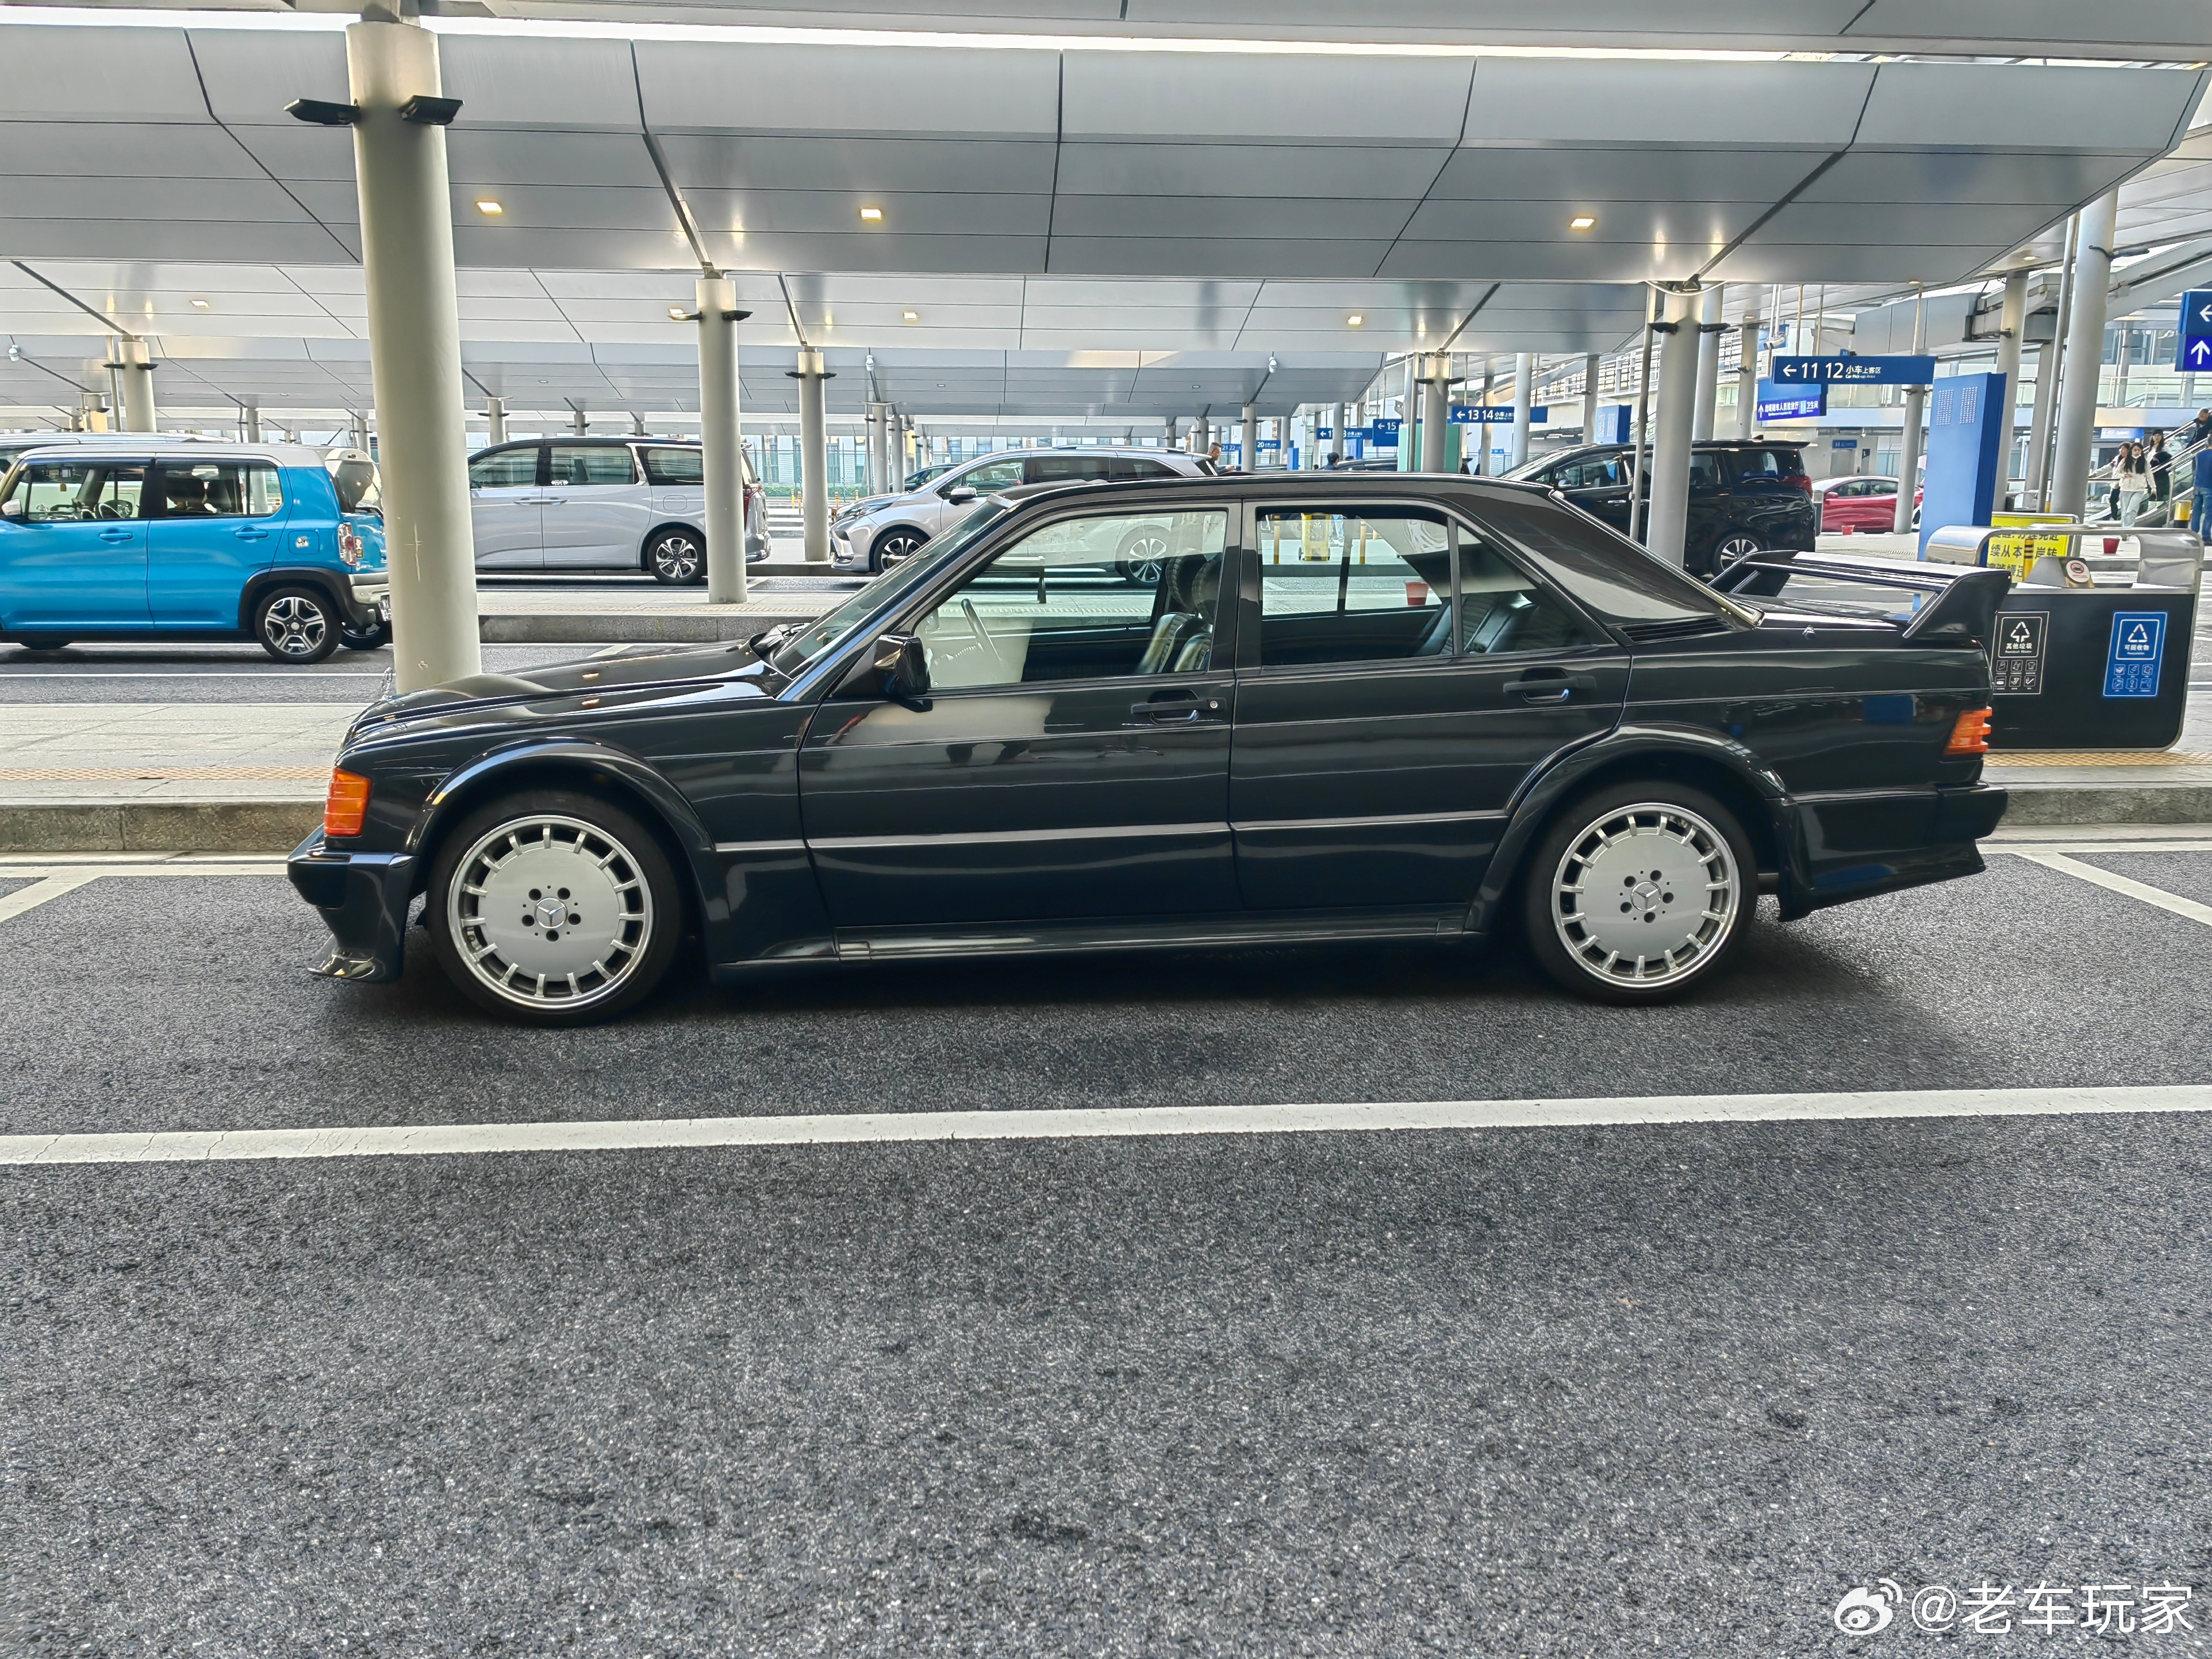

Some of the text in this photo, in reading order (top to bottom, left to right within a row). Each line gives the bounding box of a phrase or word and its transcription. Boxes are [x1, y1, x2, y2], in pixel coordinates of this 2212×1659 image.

[1801, 362, 1844, 379] 11 12
[1845, 365, 1881, 374] 小车上客区
[1468, 409, 1493, 420] 13 14
[1387, 422, 1396, 430] 15
[1991, 543, 2058, 559] 续从本岸转
